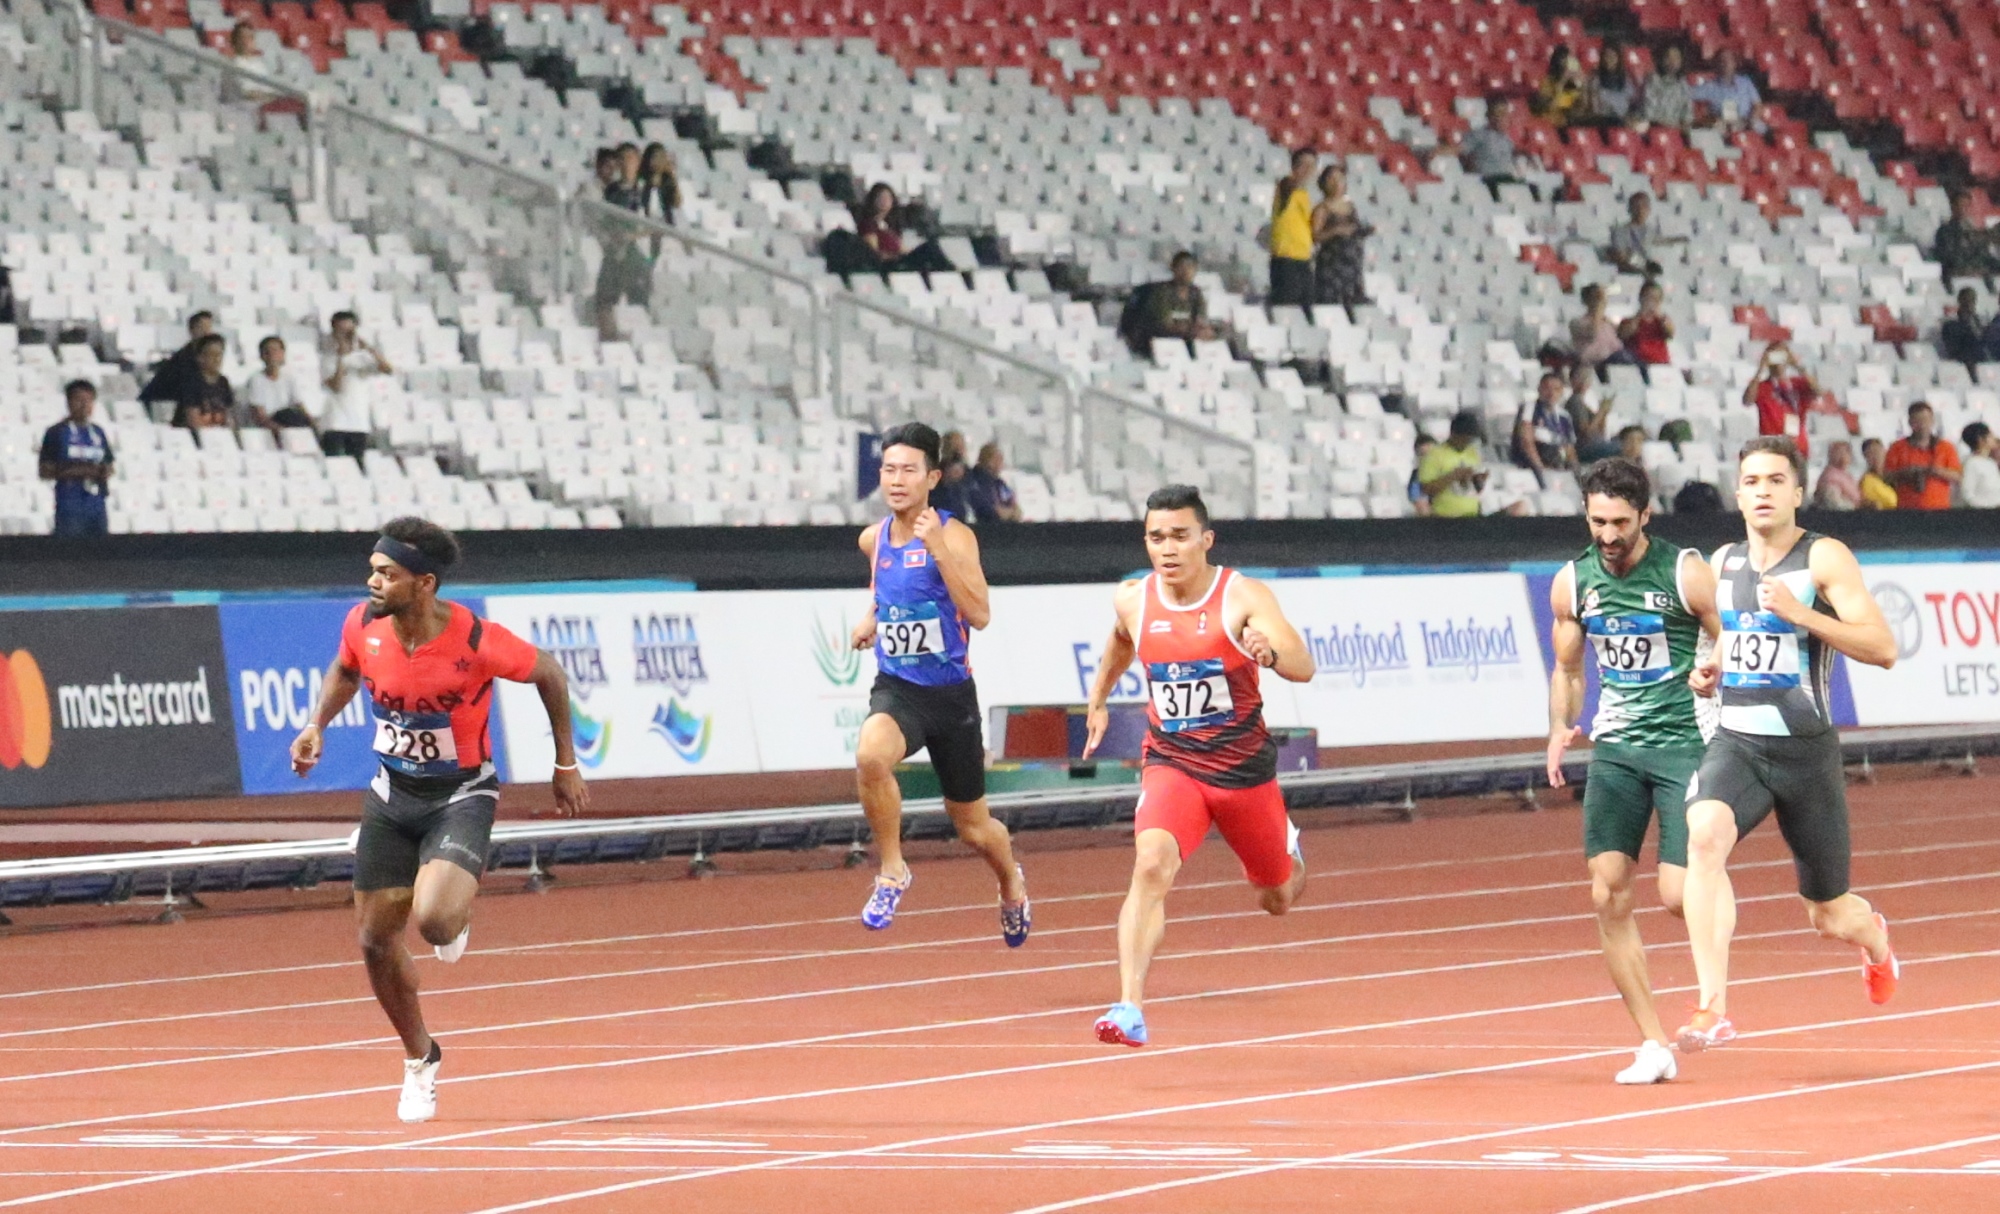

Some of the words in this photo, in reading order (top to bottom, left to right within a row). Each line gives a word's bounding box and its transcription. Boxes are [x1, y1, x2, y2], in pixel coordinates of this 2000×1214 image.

[632, 612, 708, 697] AQUA
[886, 623, 930, 655] 592
[1303, 622, 1408, 688] Indofood
[1420, 616, 1519, 682] Indofood
[1604, 636, 1651, 670] 669
[1730, 634, 1781, 672] 437
[58, 665, 212, 729] mastercard
[1162, 680, 1218, 717] 372
[384, 724, 440, 762] 228
